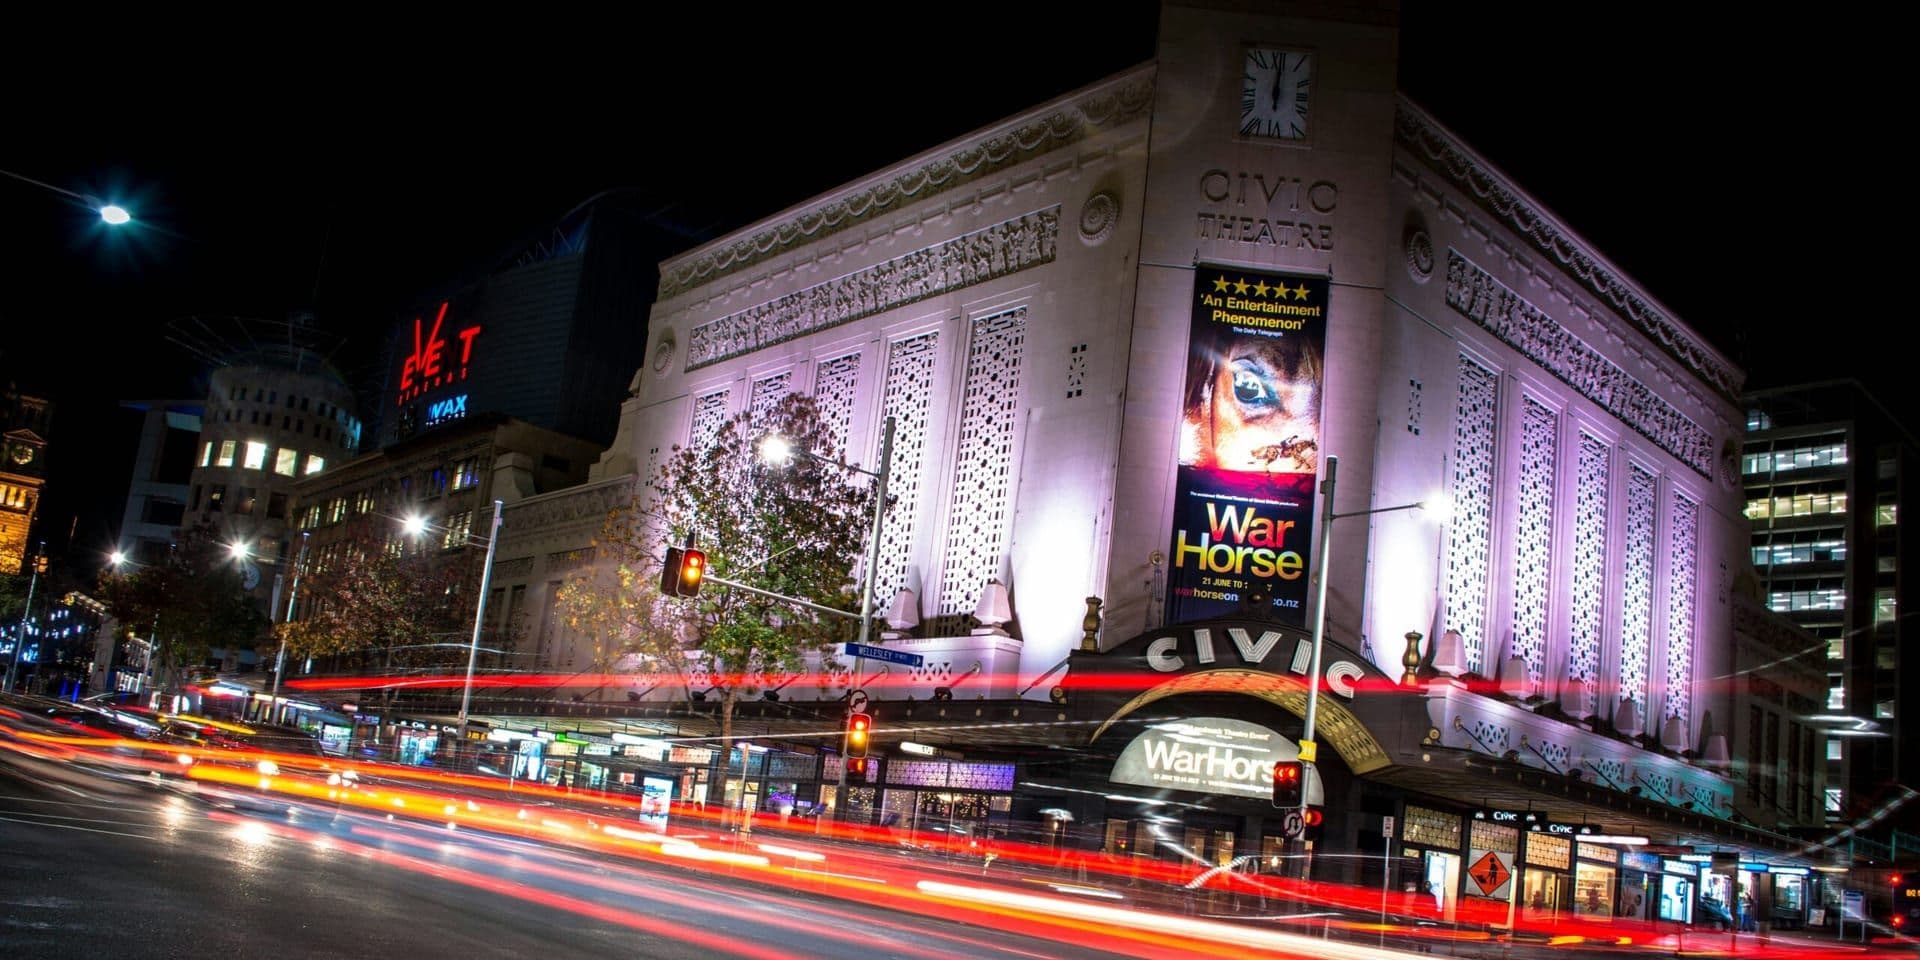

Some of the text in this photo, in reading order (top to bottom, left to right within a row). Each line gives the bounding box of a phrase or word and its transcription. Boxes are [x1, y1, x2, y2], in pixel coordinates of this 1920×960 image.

[1200, 169, 1338, 214] CIVIC
[1197, 212, 1334, 251] THEATRE
[1226, 297, 1321, 317] Entertainment
[400, 302, 481, 390] EVET
[1206, 502, 1295, 548] War
[1175, 530, 1304, 581] Horse
[1202, 577, 1211, 585] 21
[1212, 578, 1232, 588] JUNE
[1233, 580, 1243, 588] TO
[858, 646, 893, 661] WELLESLEY
[1146, 628, 1365, 699] CIVIC
[1143, 739, 1274, 783] WarHors
